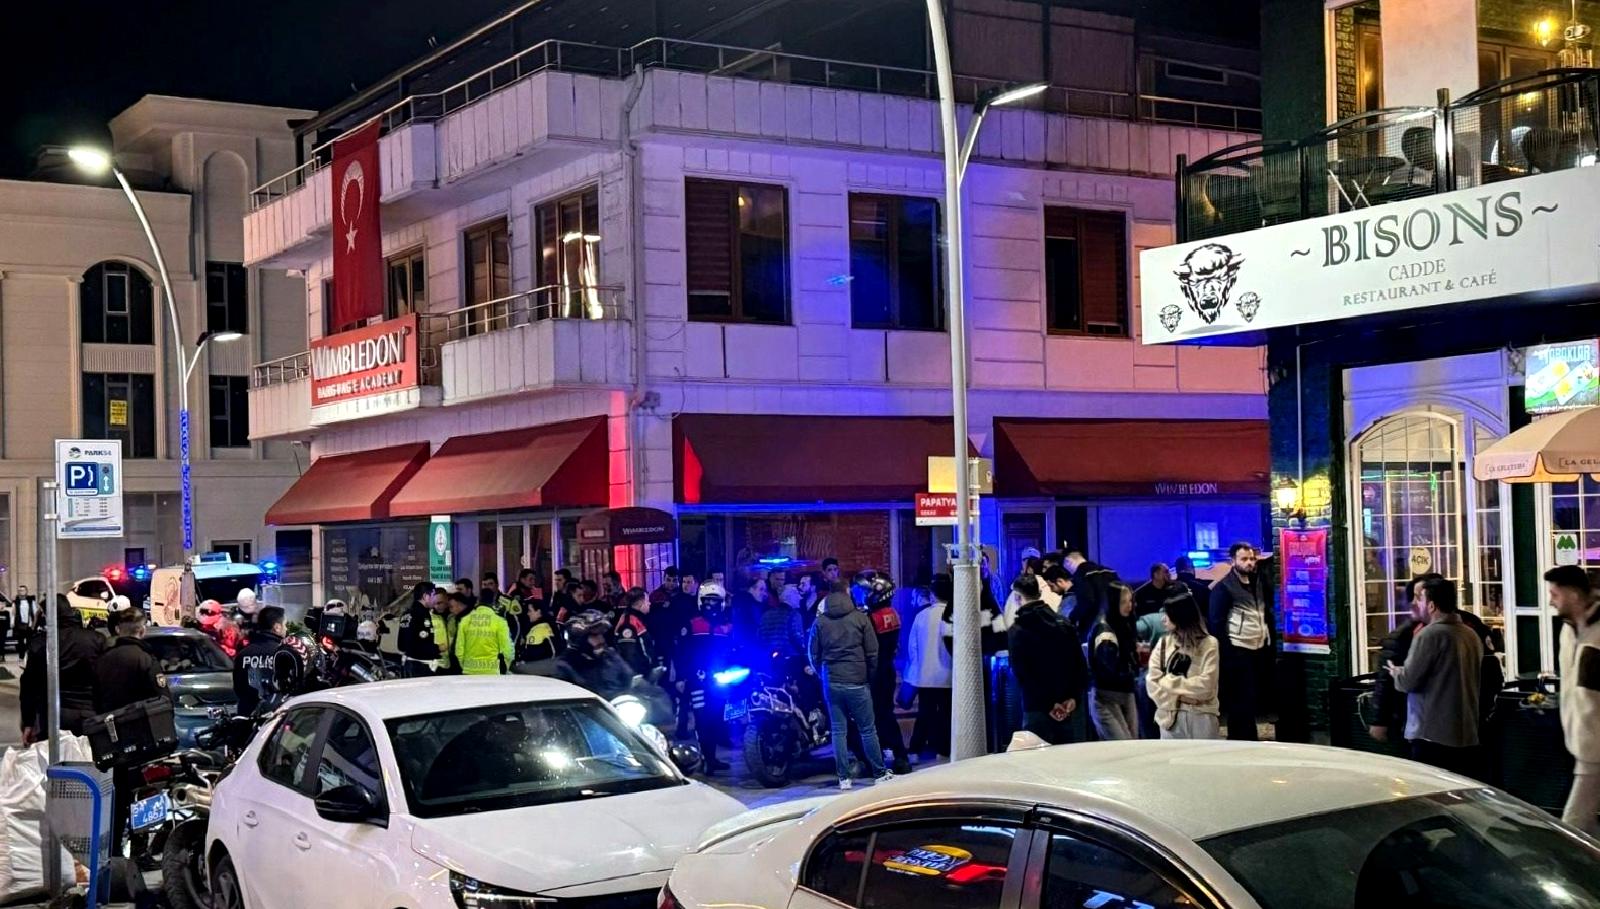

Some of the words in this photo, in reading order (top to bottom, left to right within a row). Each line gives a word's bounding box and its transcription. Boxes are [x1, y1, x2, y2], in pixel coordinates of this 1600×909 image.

[1322, 191, 1523, 267] BISONS
[1389, 258, 1446, 281] CADDE
[1343, 281, 1442, 306] RESTAURANT
[1445, 280, 1454, 291] &
[1460, 269, 1498, 289] CAFÉ
[312, 331, 400, 380] WIMBLEDON
[360, 370, 399, 391] ACADEMY
[70, 465, 86, 487] P
[1154, 483, 1218, 494] WIMBLEDON
[920, 497, 957, 507] PAPATYA
